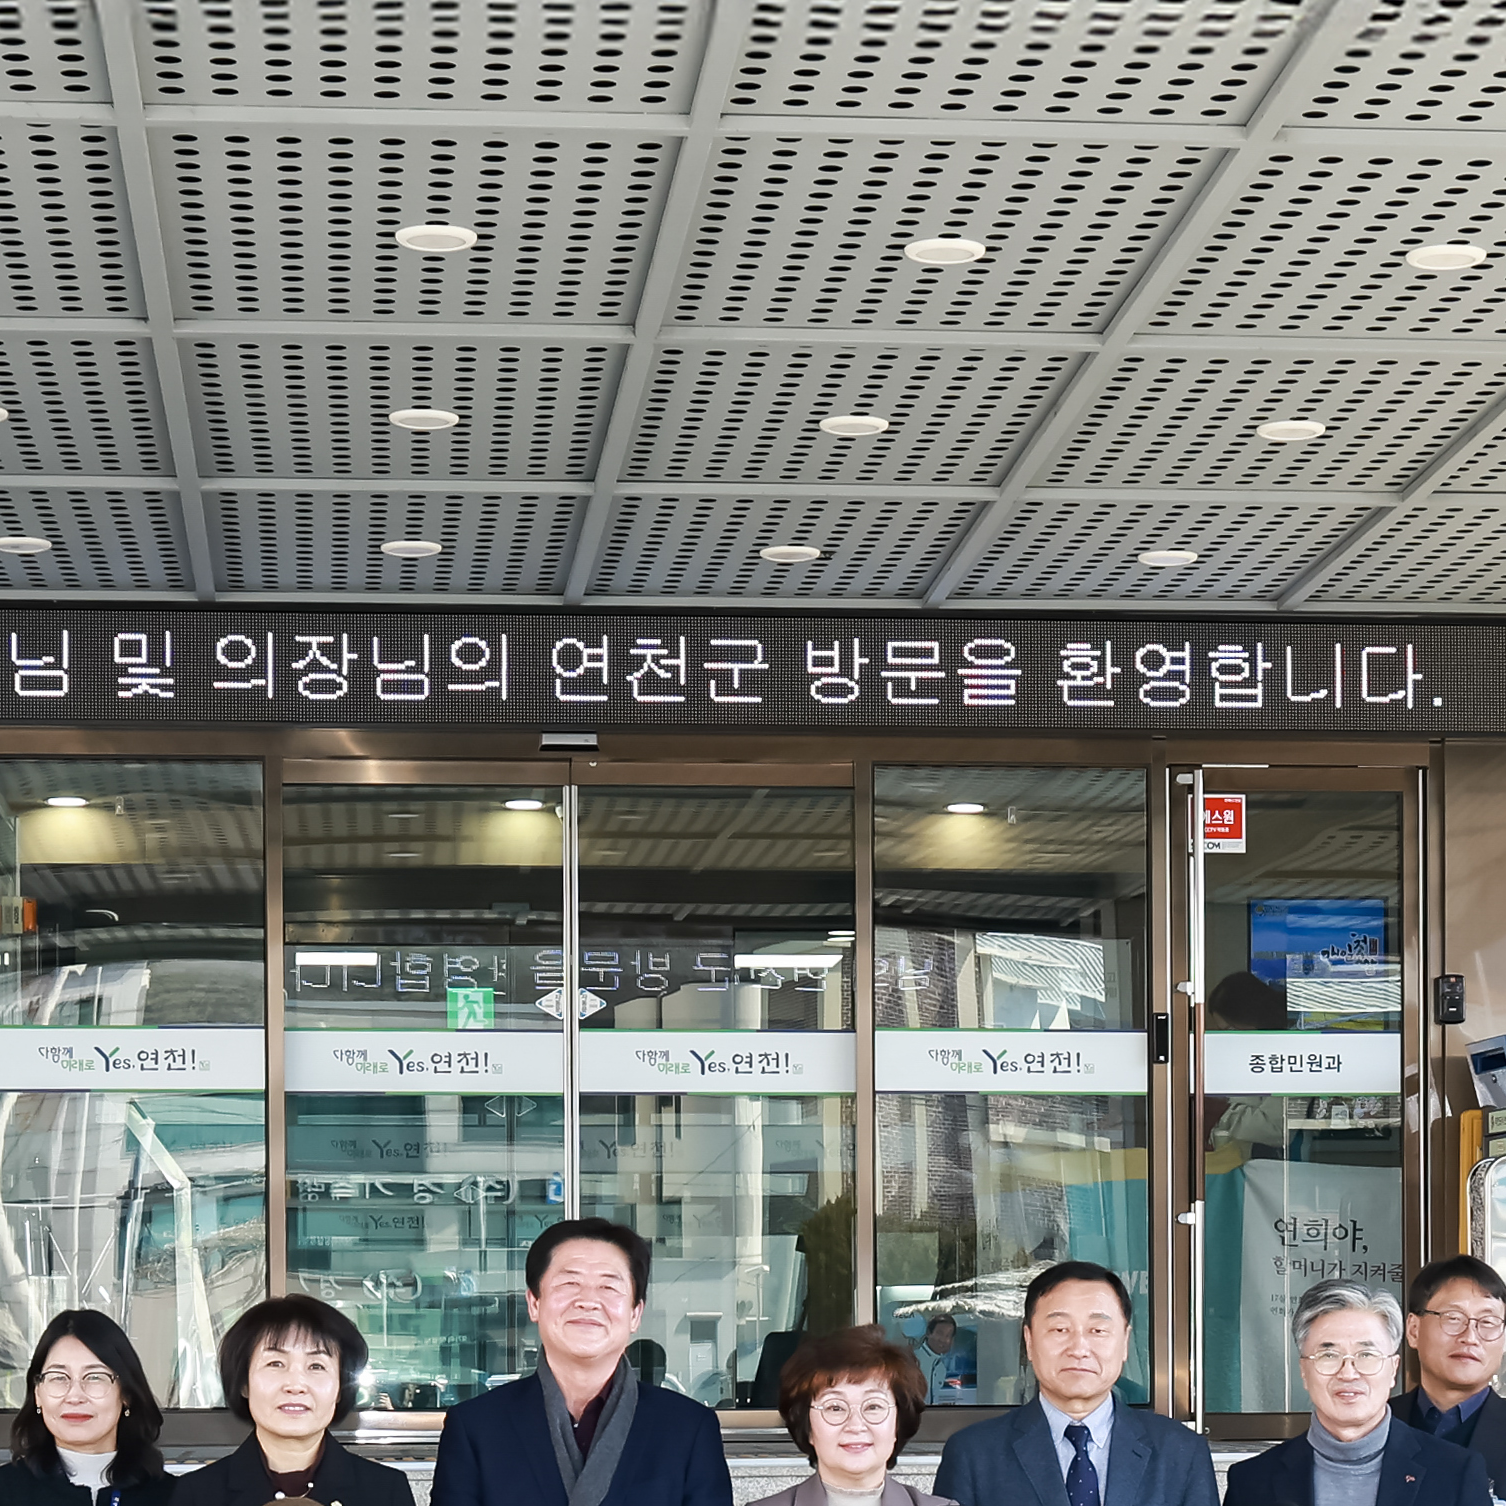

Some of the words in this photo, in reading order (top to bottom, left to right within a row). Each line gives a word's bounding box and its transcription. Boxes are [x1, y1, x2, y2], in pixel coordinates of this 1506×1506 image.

[112, 630, 176, 699] 및
[212, 631, 509, 701] 의장님의
[550, 634, 770, 704] 연천군
[805, 637, 1023, 706] 방문을
[1056, 640, 1444, 709] 환영합니다.
[38, 1046, 74, 1063] 다함께
[137, 1048, 196, 1071] 연천!
[333, 1049, 367, 1066] 다함께
[430, 1051, 489, 1074] 연천!
[635, 1050, 670, 1066] 다함께
[732, 1052, 789, 1074] 연천!
[928, 1049, 962, 1066] 다함께
[1024, 1051, 1081, 1073] 연천!
[1248, 1053, 1343, 1074] 종합민원과
[61, 1059, 95, 1072] 미래로
[355, 1062, 389, 1074] 미래로
[657, 1062, 691, 1075] 미래로
[950, 1062, 983, 1074] 미래로
[1274, 1217, 1368, 1254] 연희야,
[1273, 1256, 1346, 1280] 할머니가
